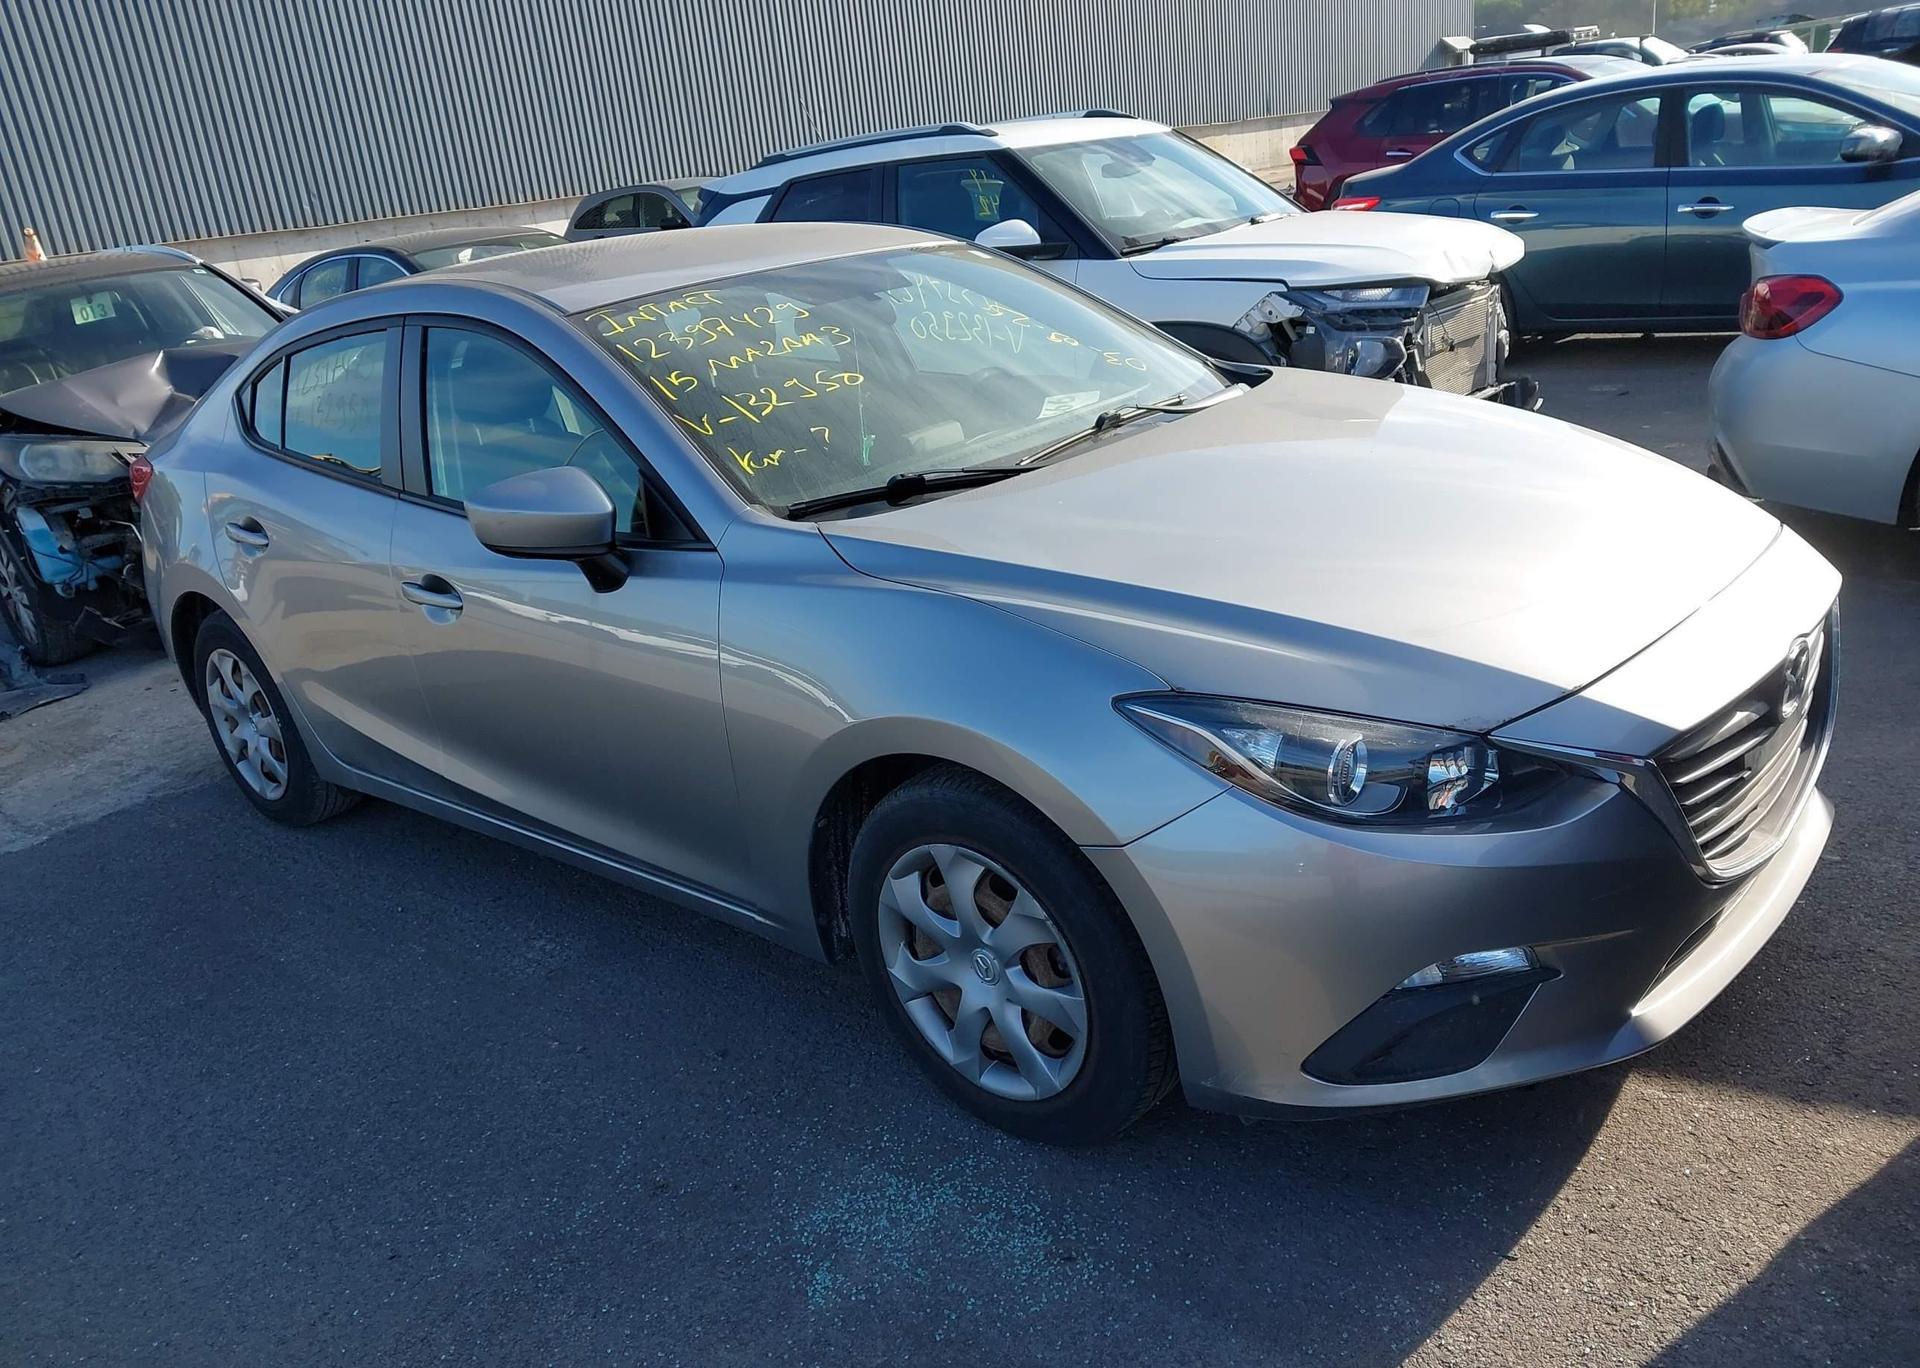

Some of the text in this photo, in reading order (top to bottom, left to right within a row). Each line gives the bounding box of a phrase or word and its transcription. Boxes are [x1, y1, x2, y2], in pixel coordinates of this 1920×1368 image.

[80, 303, 108, 321] 013
[585, 290, 722, 336] INTACT
[650, 370, 698, 401] 15
